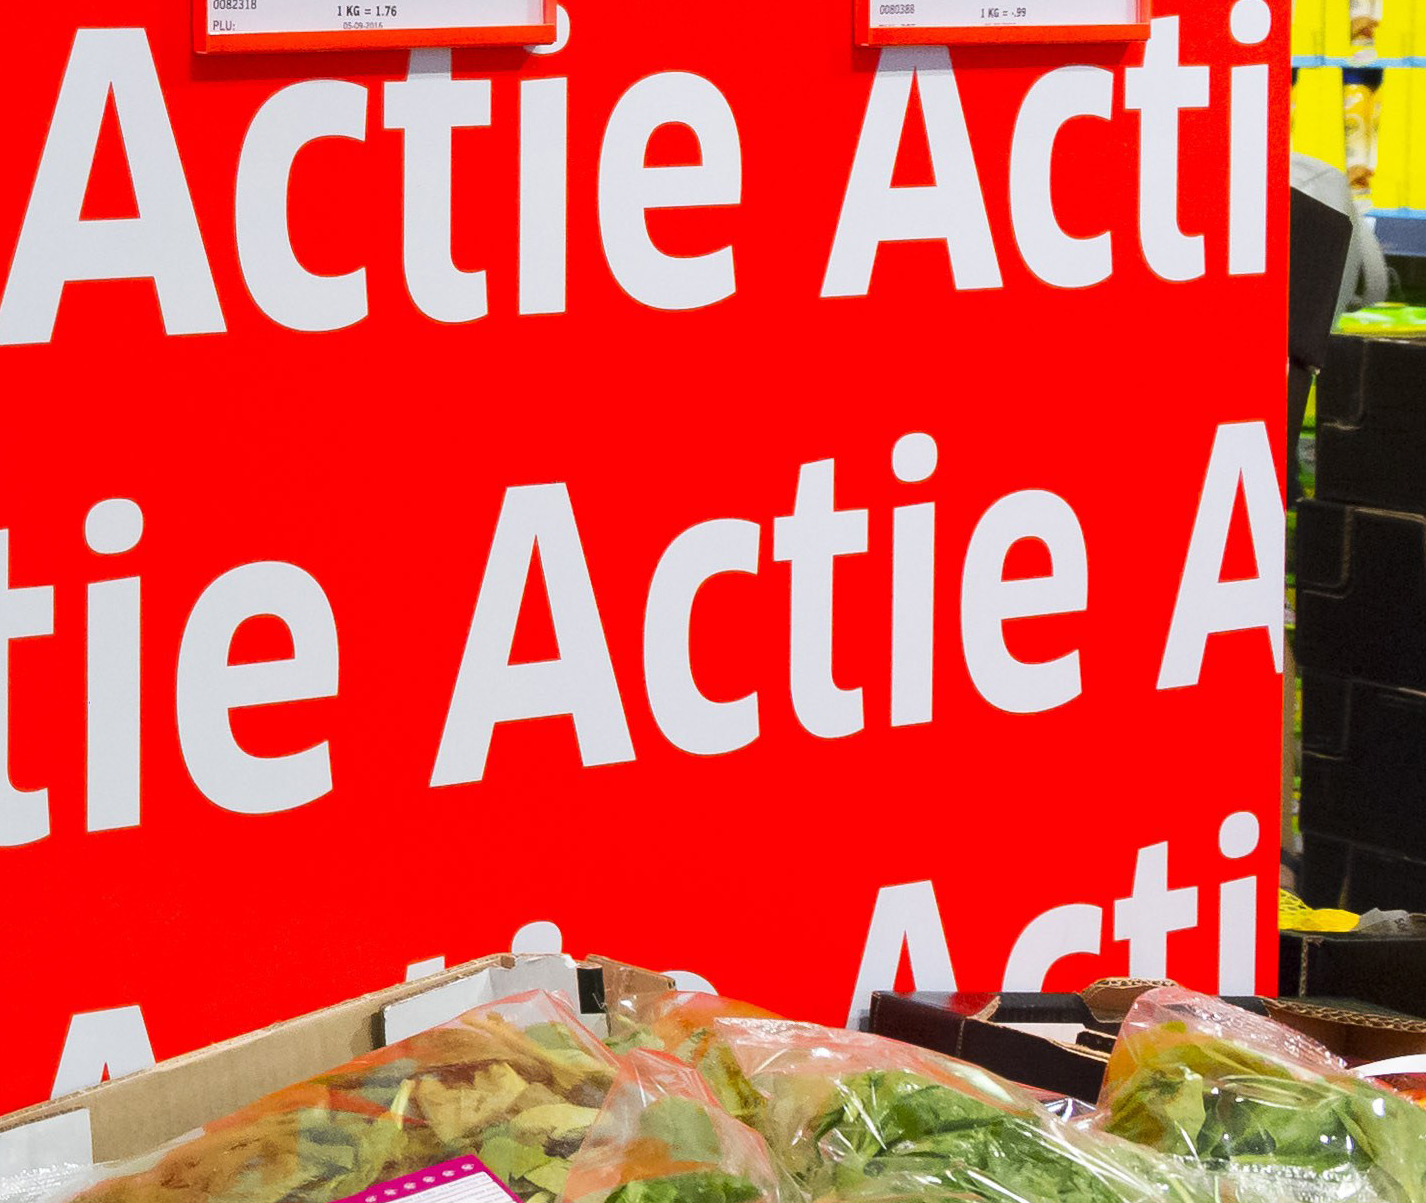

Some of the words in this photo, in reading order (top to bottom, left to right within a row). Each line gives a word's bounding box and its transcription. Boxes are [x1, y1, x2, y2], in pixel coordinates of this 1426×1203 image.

[213, 0, 257, 10] 0082318
[346, 6, 360, 17] KG
[376, 5, 397, 17] 1.76
[988, 8, 1000, 19] KG
[213, 20, 236, 32] PLU:
[430, 433, 1089, 788] Actie
